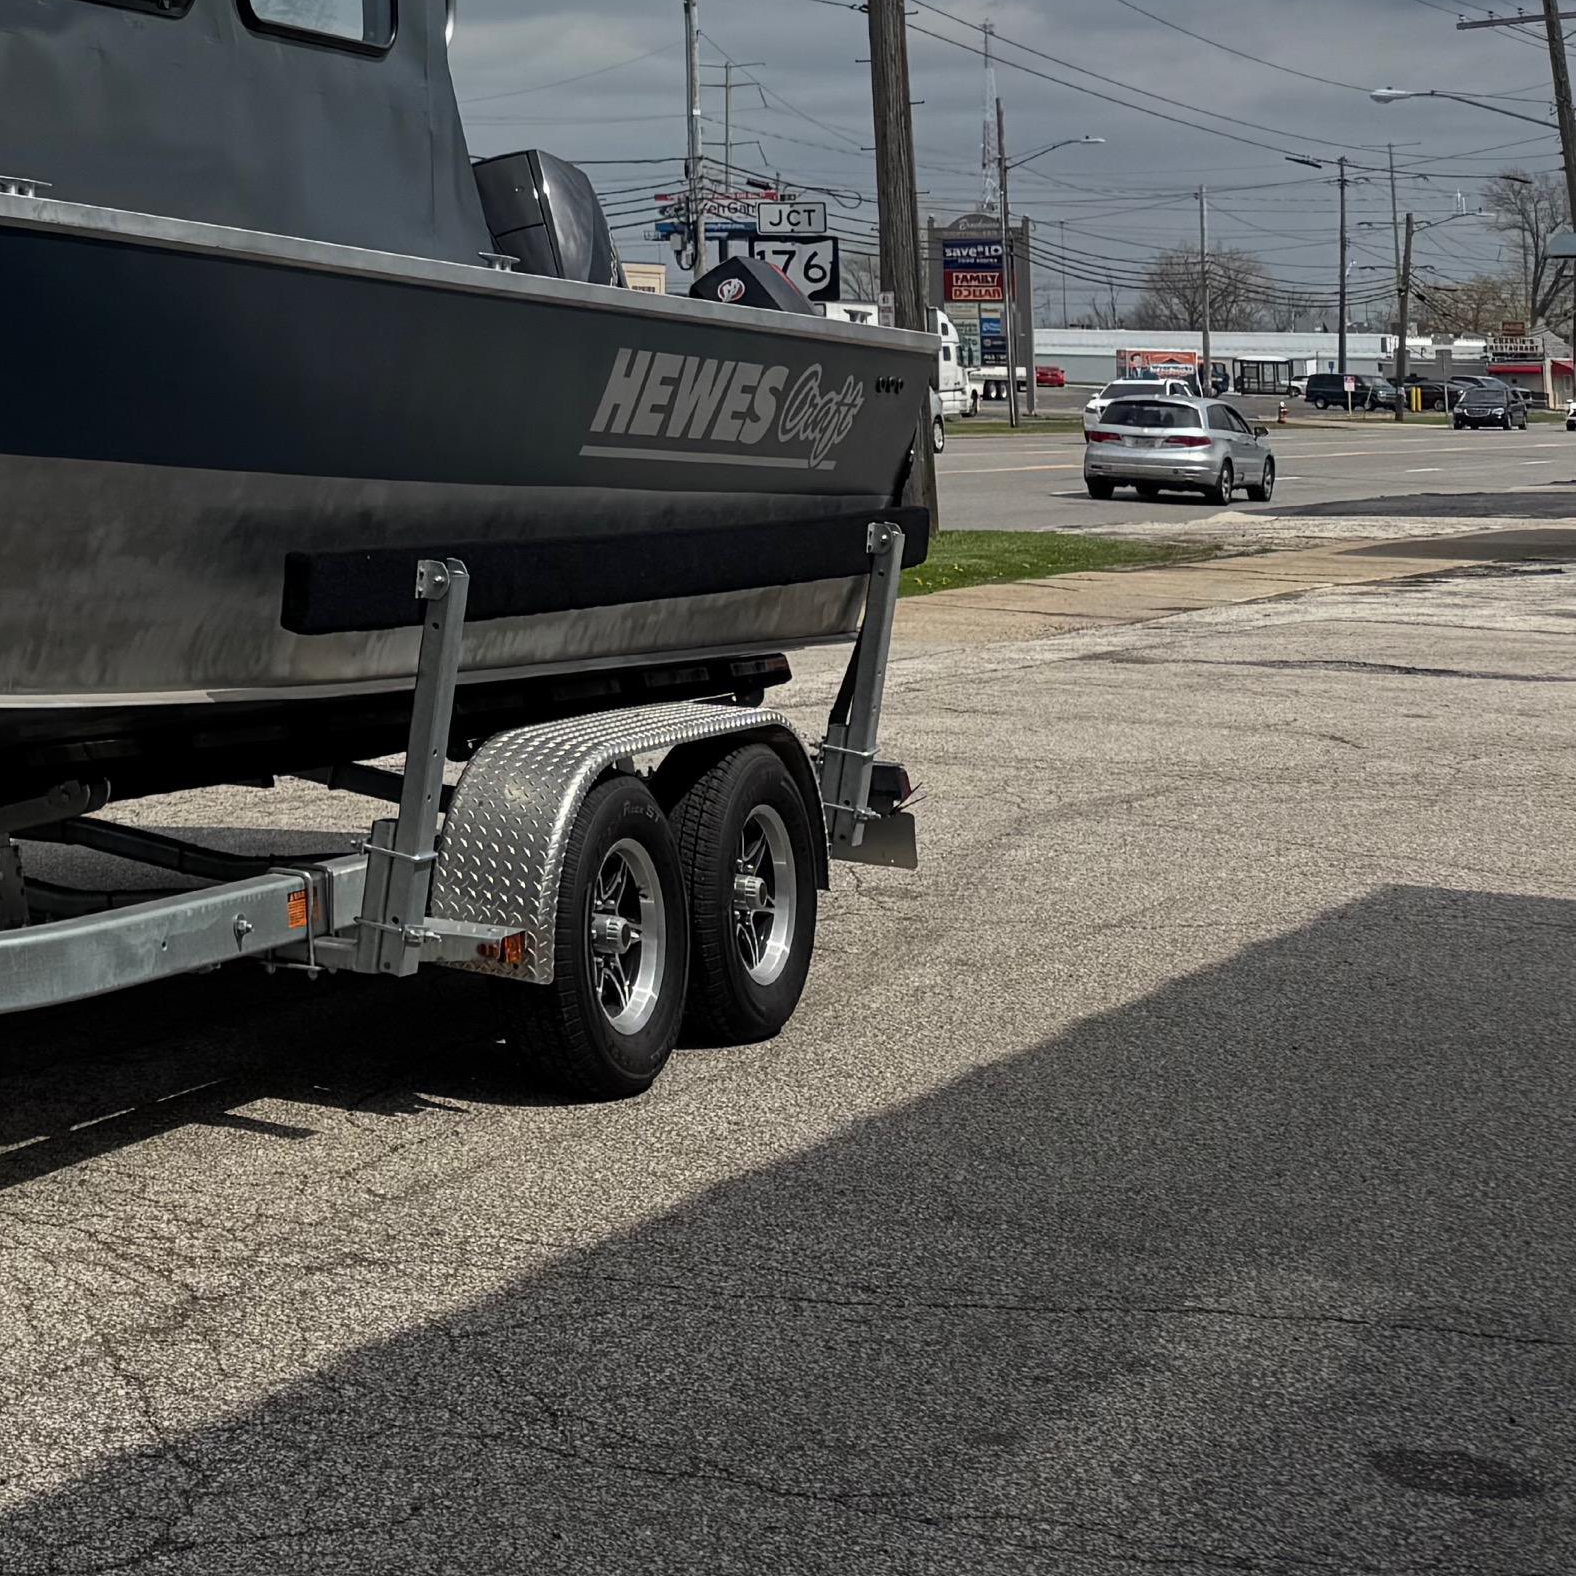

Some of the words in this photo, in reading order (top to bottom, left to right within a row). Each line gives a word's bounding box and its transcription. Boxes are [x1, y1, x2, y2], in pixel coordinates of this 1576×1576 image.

[769, 209, 816, 227] JCT
[953, 273, 999, 285] FAMILY
[952, 287, 1002, 299] DOLLAR
[589, 348, 790, 444] HEWES
[777, 363, 865, 468] Craft
